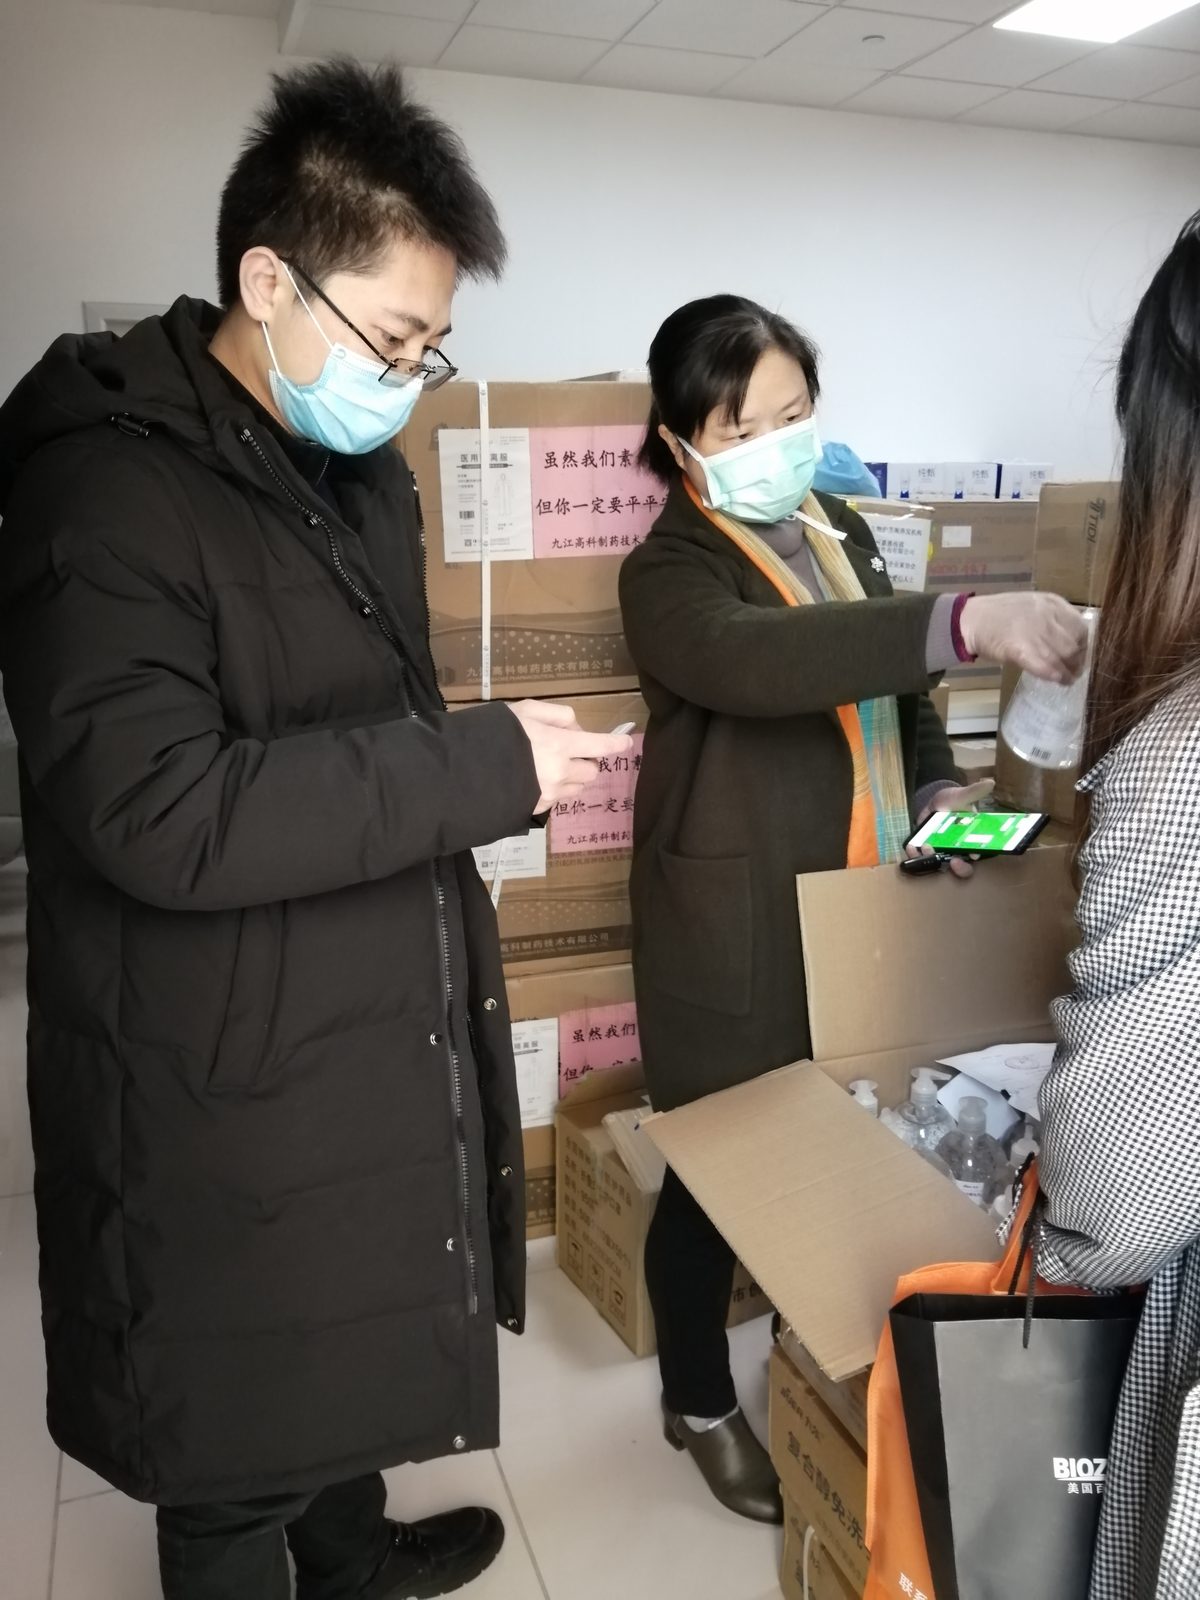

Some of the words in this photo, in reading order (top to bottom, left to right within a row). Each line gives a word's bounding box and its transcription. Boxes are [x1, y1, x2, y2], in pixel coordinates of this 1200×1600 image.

[460, 453, 508, 463] 医用离服
[544, 449, 634, 469] 虽然我们素
[552, 534, 646, 549] 九江高科制药技术
[573, 1023, 636, 1043] 虽然我们
